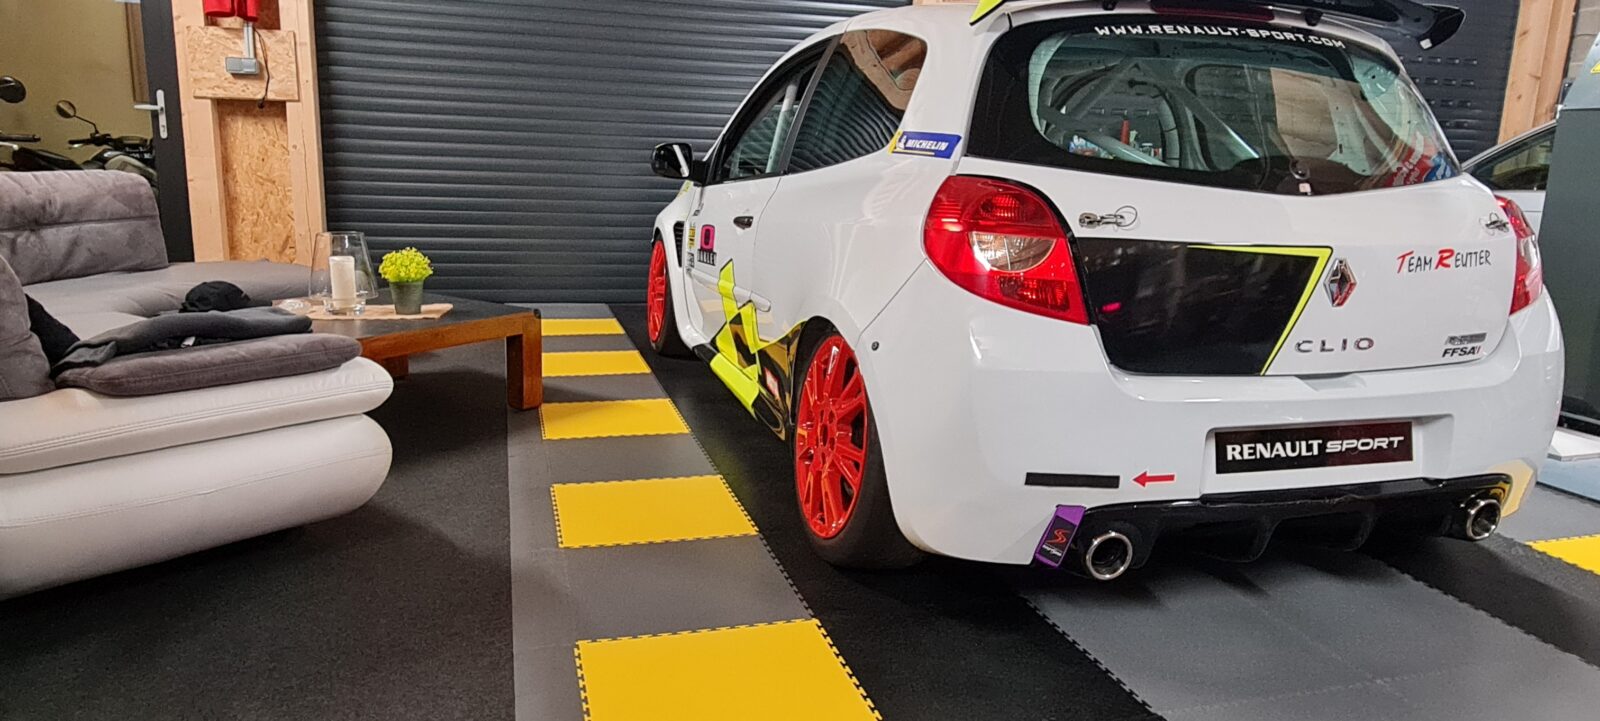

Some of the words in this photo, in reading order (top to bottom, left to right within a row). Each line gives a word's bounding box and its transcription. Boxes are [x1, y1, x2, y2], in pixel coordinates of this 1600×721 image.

[1094, 24, 1346, 48] WWW.RENAULT-SPORT.COM
[905, 139, 949, 151] MICHELIN
[1397, 251, 1433, 273] TEAM
[1436, 249, 1491, 270] REUTTER
[1296, 337, 1374, 353] CLIO
[1226, 439, 1322, 461] RENAULT
[1326, 436, 1404, 454] SPORT
